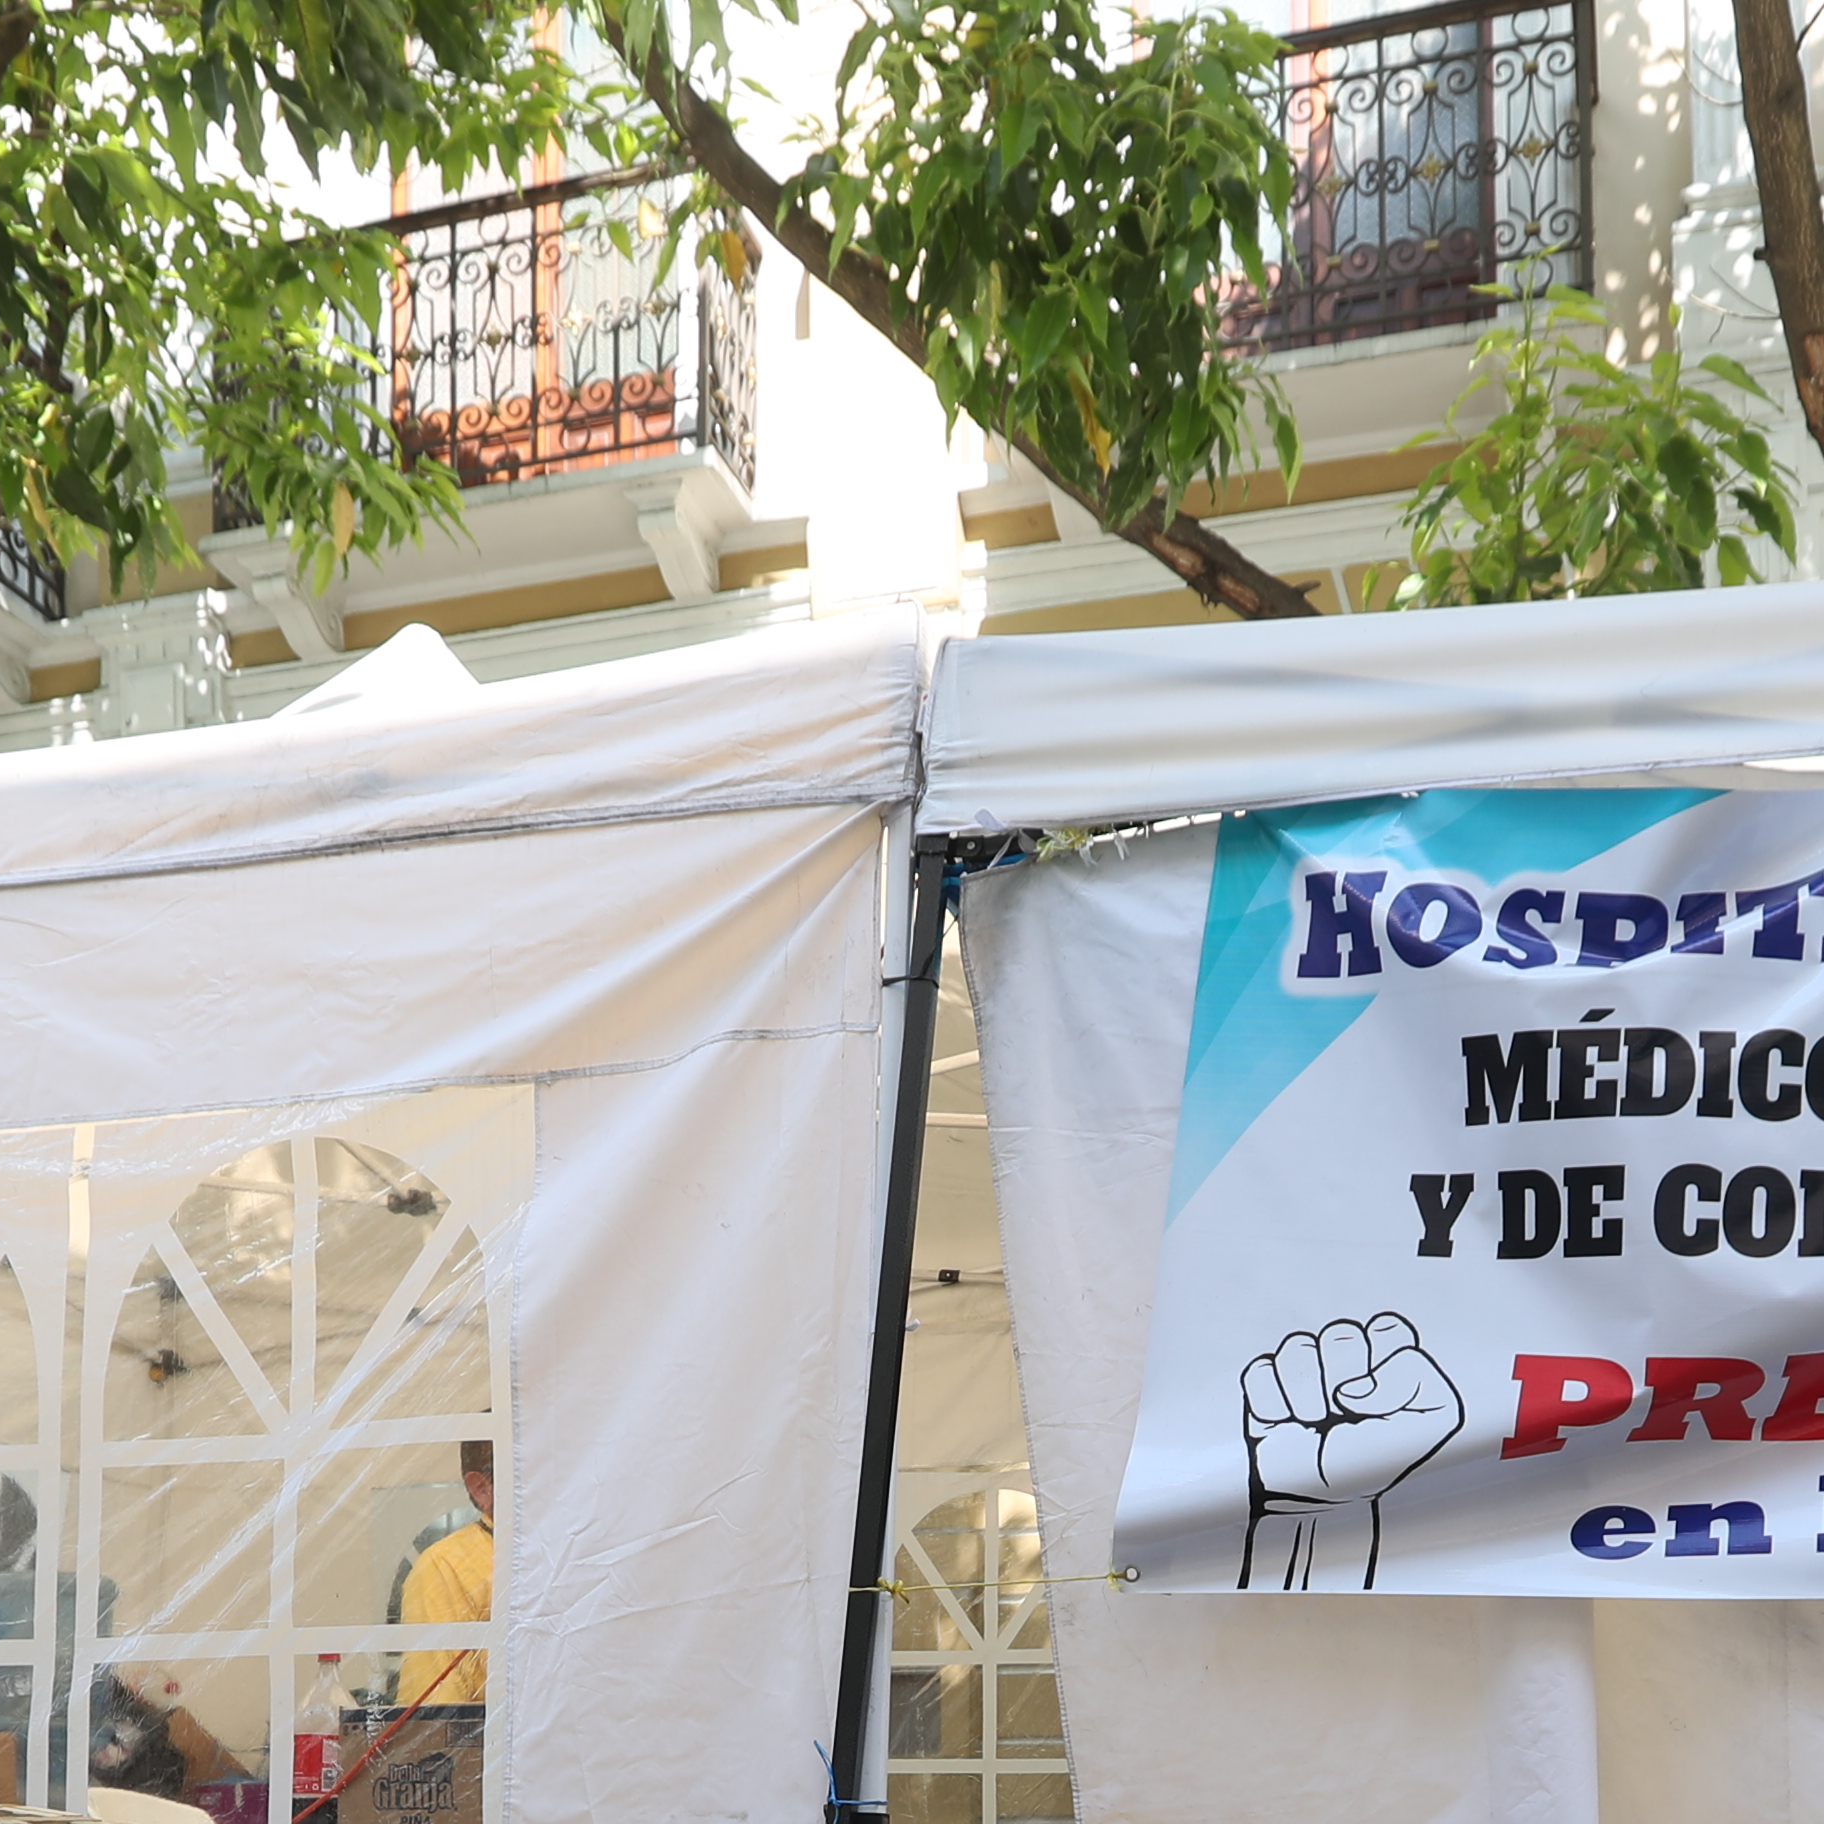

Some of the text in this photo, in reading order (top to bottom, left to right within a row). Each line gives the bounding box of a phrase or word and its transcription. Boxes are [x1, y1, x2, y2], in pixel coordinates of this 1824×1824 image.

[1409, 1173, 1476, 1260] Y
[1498, 1168, 1625, 1261] DE
[1569, 1495, 1773, 1558] en
[374, 1777, 456, 1814] Granja
